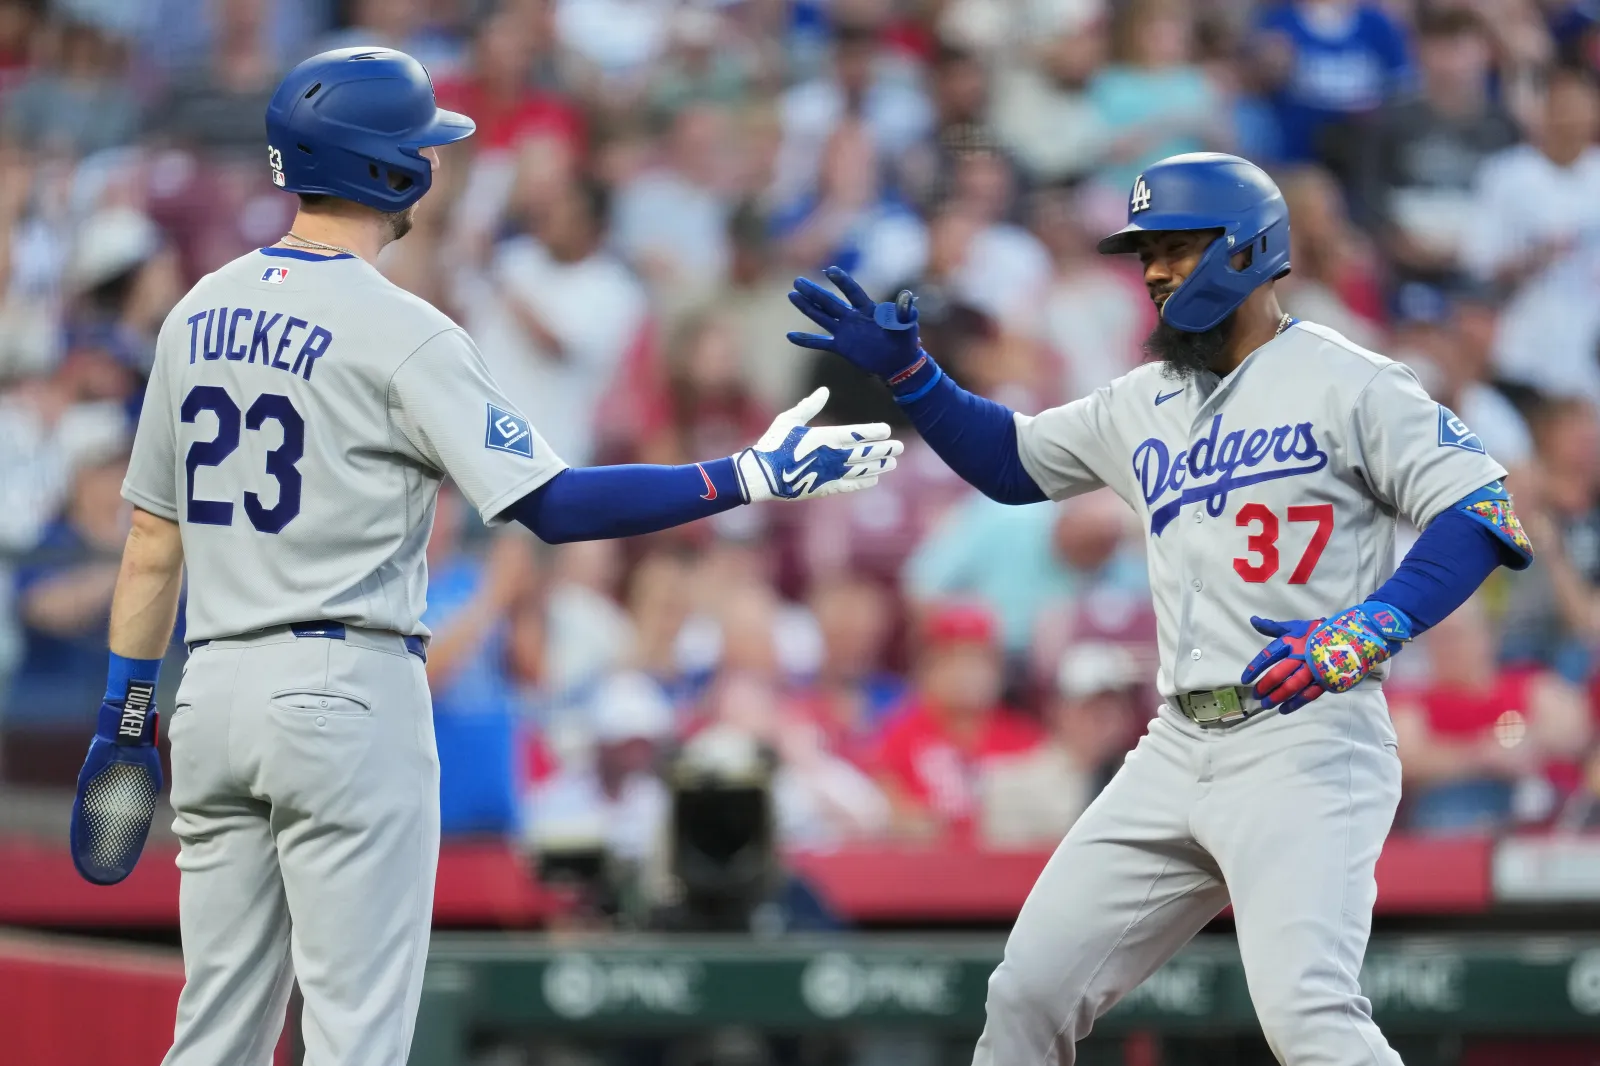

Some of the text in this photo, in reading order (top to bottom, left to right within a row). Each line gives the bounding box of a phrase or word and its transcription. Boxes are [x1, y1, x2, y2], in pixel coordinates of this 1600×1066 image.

[267, 145, 282, 170] 23
[1131, 174, 1151, 213] LA
[187, 307, 333, 381] TUCKER
[180, 385, 305, 534] 23
[1132, 413, 1328, 520] Dodgers
[1233, 503, 1334, 584] 37
[119, 686, 153, 737] TUCKER
